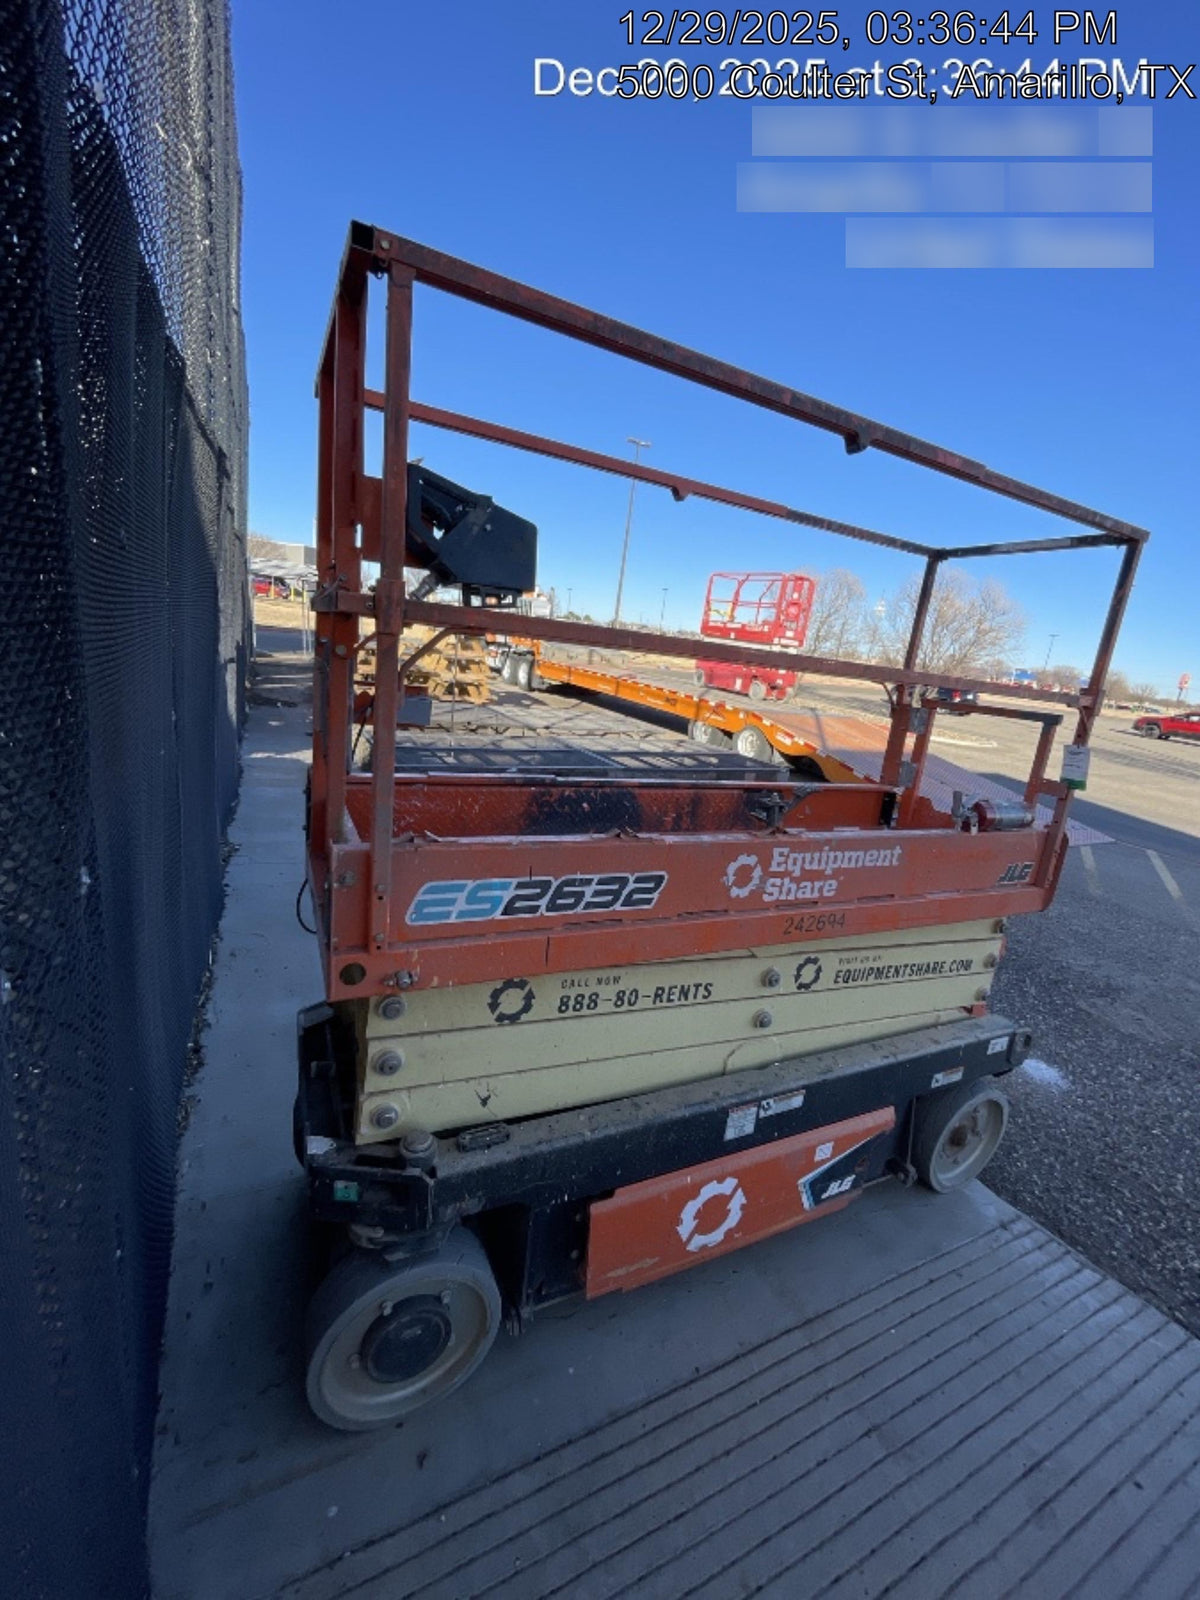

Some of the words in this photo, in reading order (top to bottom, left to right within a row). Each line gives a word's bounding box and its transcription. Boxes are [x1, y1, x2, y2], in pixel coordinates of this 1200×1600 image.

[769, 846, 901, 875] Equipment
[998, 862, 1035, 883] JLG
[405, 871, 668, 925] ES2632
[762, 876, 838, 901] Share
[784, 913, 845, 935] 242694
[561, 977, 590, 989] CALL
[595, 974, 622, 987] NOW
[834, 960, 973, 984] EQUIPMENTSHARE.COM
[557, 983, 714, 1014] 888-80-RENTS
[821, 1174, 856, 1199] JLG
